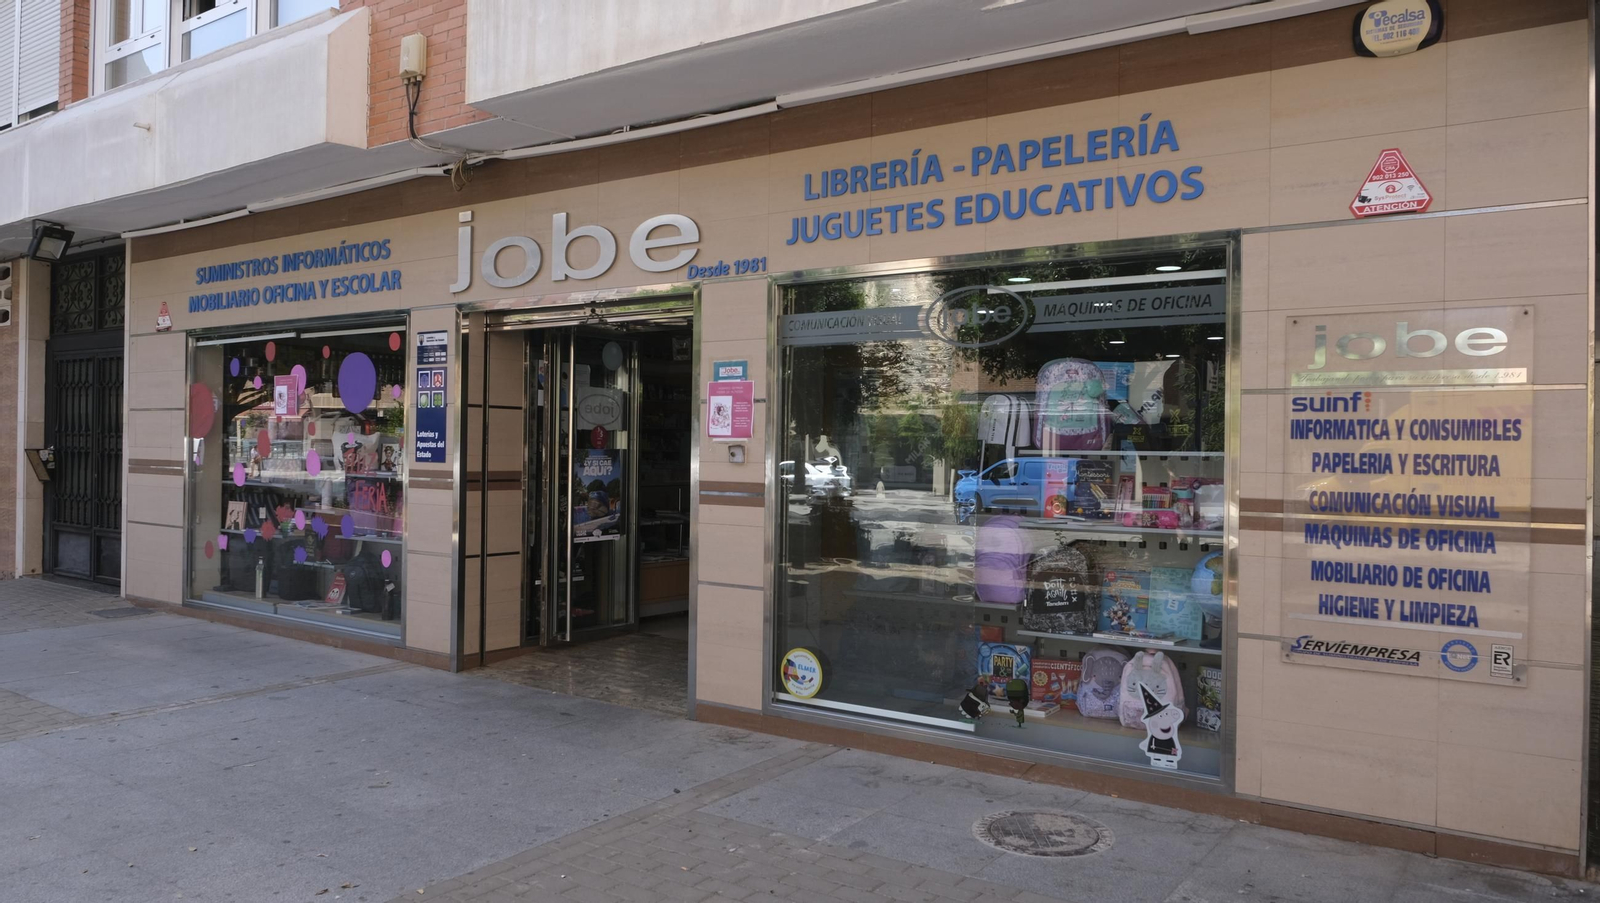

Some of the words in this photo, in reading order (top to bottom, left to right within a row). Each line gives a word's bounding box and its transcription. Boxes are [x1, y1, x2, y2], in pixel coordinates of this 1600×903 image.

[804, 148, 944, 200] LIBRERÍA
[971, 113, 1180, 177] PAPELERÍA
[786, 199, 946, 246] JUGUETES
[954, 166, 1205, 226] EDUCATIVOS
[1364, 201, 1417, 213] ATENCIÓN
[196, 255, 278, 285] SUMINISTROS
[282, 239, 391, 273] INFORMÁTICOS
[449, 210, 700, 294] jobe
[687, 260, 730, 280] Desde
[733, 256, 767, 274] 1981
[188, 286, 260, 314] MOBILIARIO
[262, 282, 316, 305] OFICINA
[318, 279, 330, 299] Y
[332, 270, 402, 297] ESCOLAR
[1126, 298, 1148, 313] DE
[1151, 294, 1212, 311] OFICINA
[942, 302, 1012, 332] jobe
[1308, 321, 1508, 370] jobe
[1290, 419, 1390, 440] INFORMATICA
[1395, 419, 1404, 440] Y
[1409, 418, 1522, 441] CONSUMIBLES
[1312, 452, 1393, 474] PAPELERIA
[1398, 454, 1408, 474] Y
[1413, 454, 1501, 477] ESCRITURA
[1309, 488, 1432, 516] COMUNICACIÓN
[1437, 494, 1499, 518] VISUAL
[1304, 523, 1392, 549] MAQUINAS
[1398, 527, 1420, 550] DE
[1426, 528, 1496, 554] OFICINA
[1311, 560, 1398, 587] MOBILIARIO
[1403, 565, 1422, 589] DE
[1427, 567, 1491, 594] OFICINA
[1318, 594, 1379, 620] HIGIENE
[1384, 598, 1395, 620] Y
[1400, 600, 1479, 628] LIMPIEZA
[798, 664, 816, 674] ELMER
[994, 656, 1013, 667] PARTY
